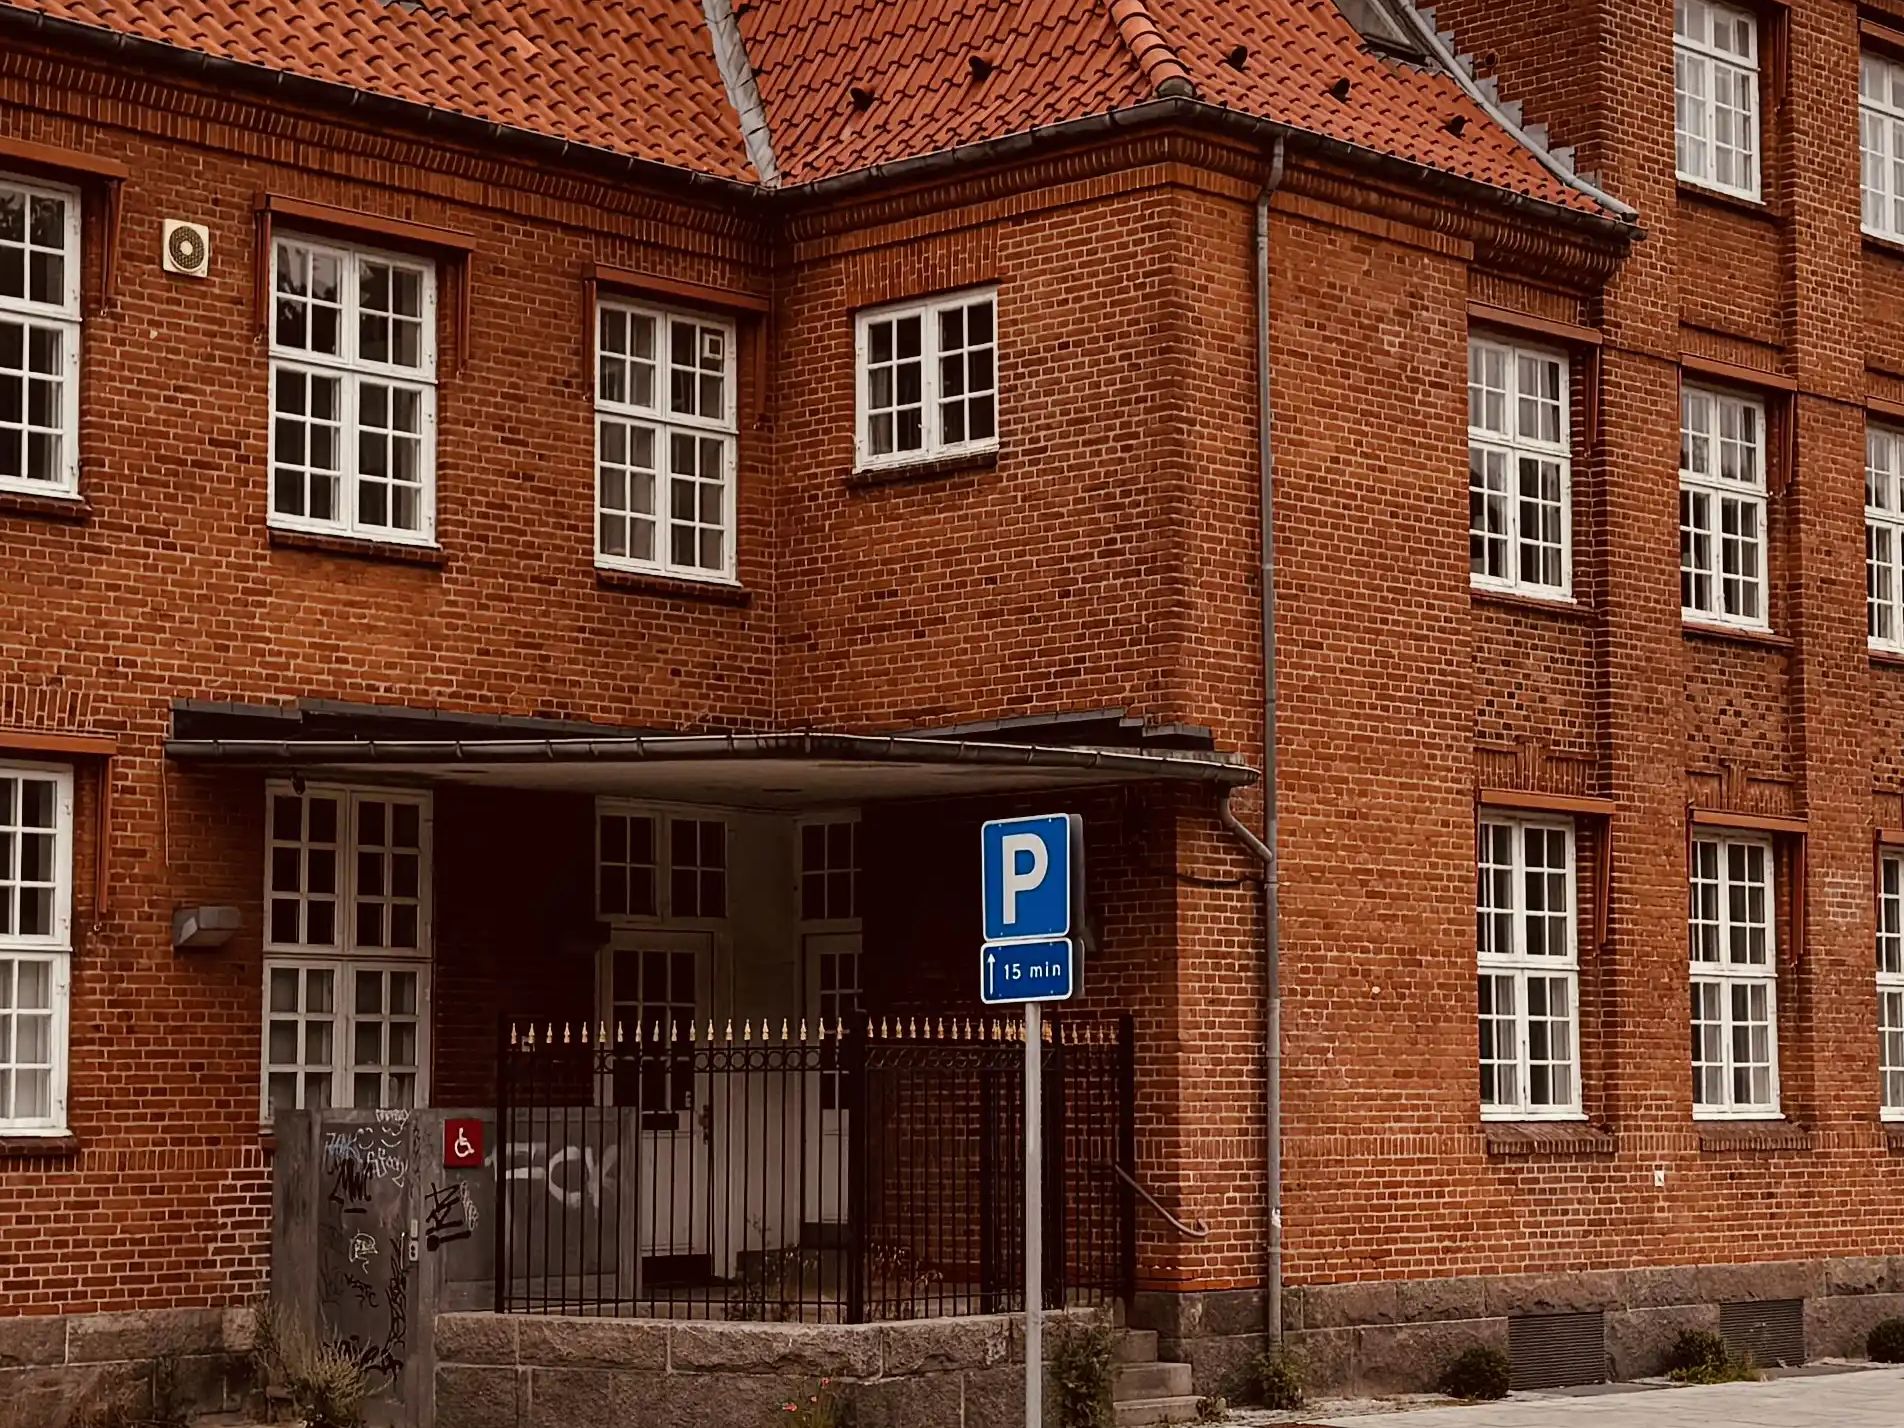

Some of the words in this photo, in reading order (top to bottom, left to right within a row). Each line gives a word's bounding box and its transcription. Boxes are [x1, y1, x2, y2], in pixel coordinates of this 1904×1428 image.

[1002, 834, 1048, 924] P
[1004, 963, 1021, 980] 15
[1029, 962, 1060, 978] min
